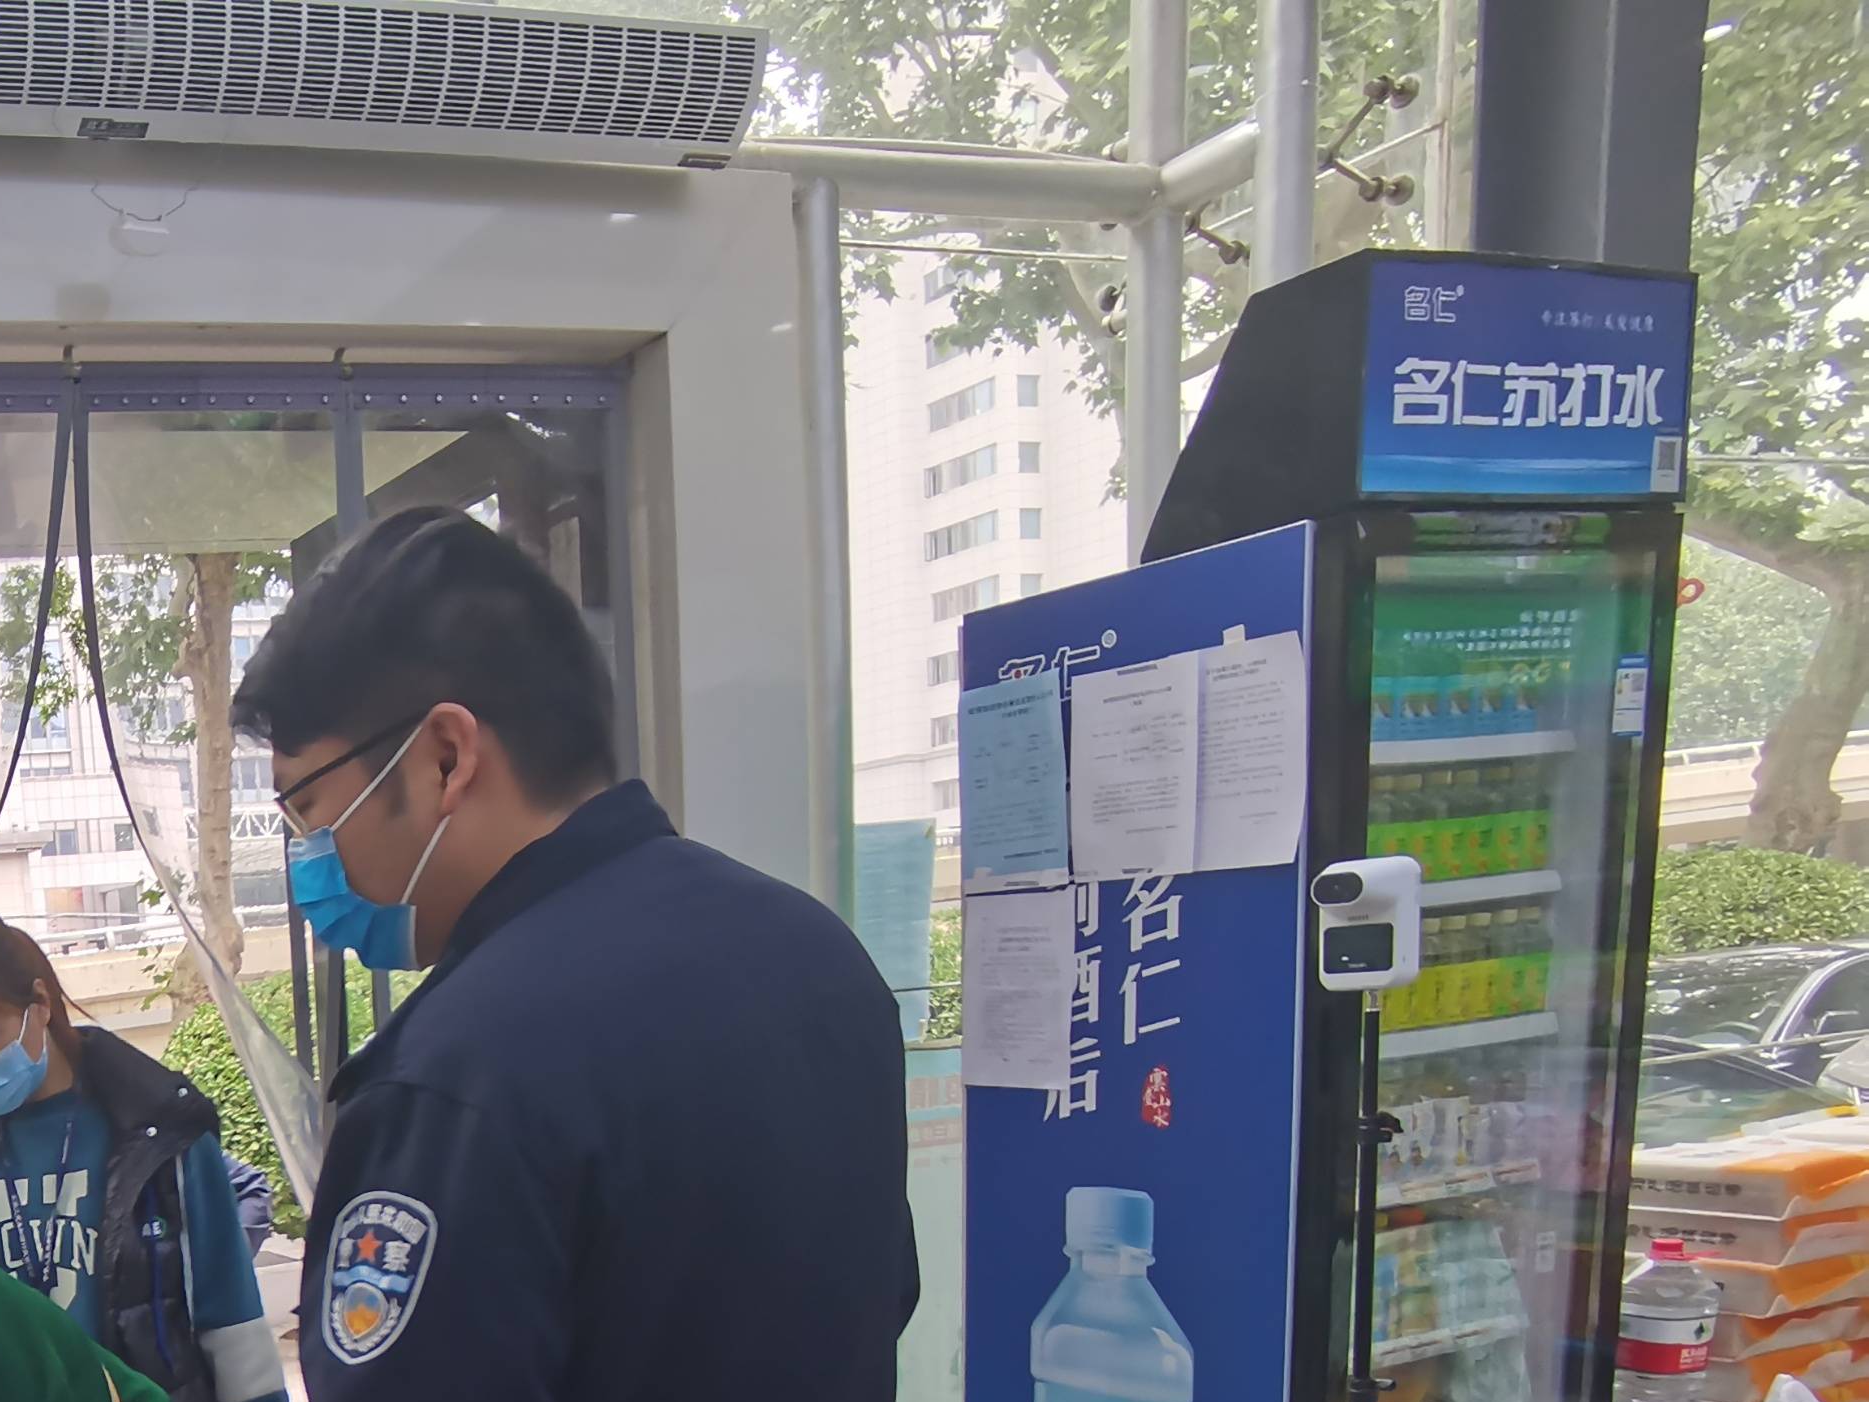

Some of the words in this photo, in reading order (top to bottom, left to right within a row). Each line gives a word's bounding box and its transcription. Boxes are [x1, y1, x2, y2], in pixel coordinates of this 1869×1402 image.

[1404, 285, 1457, 323] 名仁
[1392, 356, 1666, 428] 名仁苏打水
